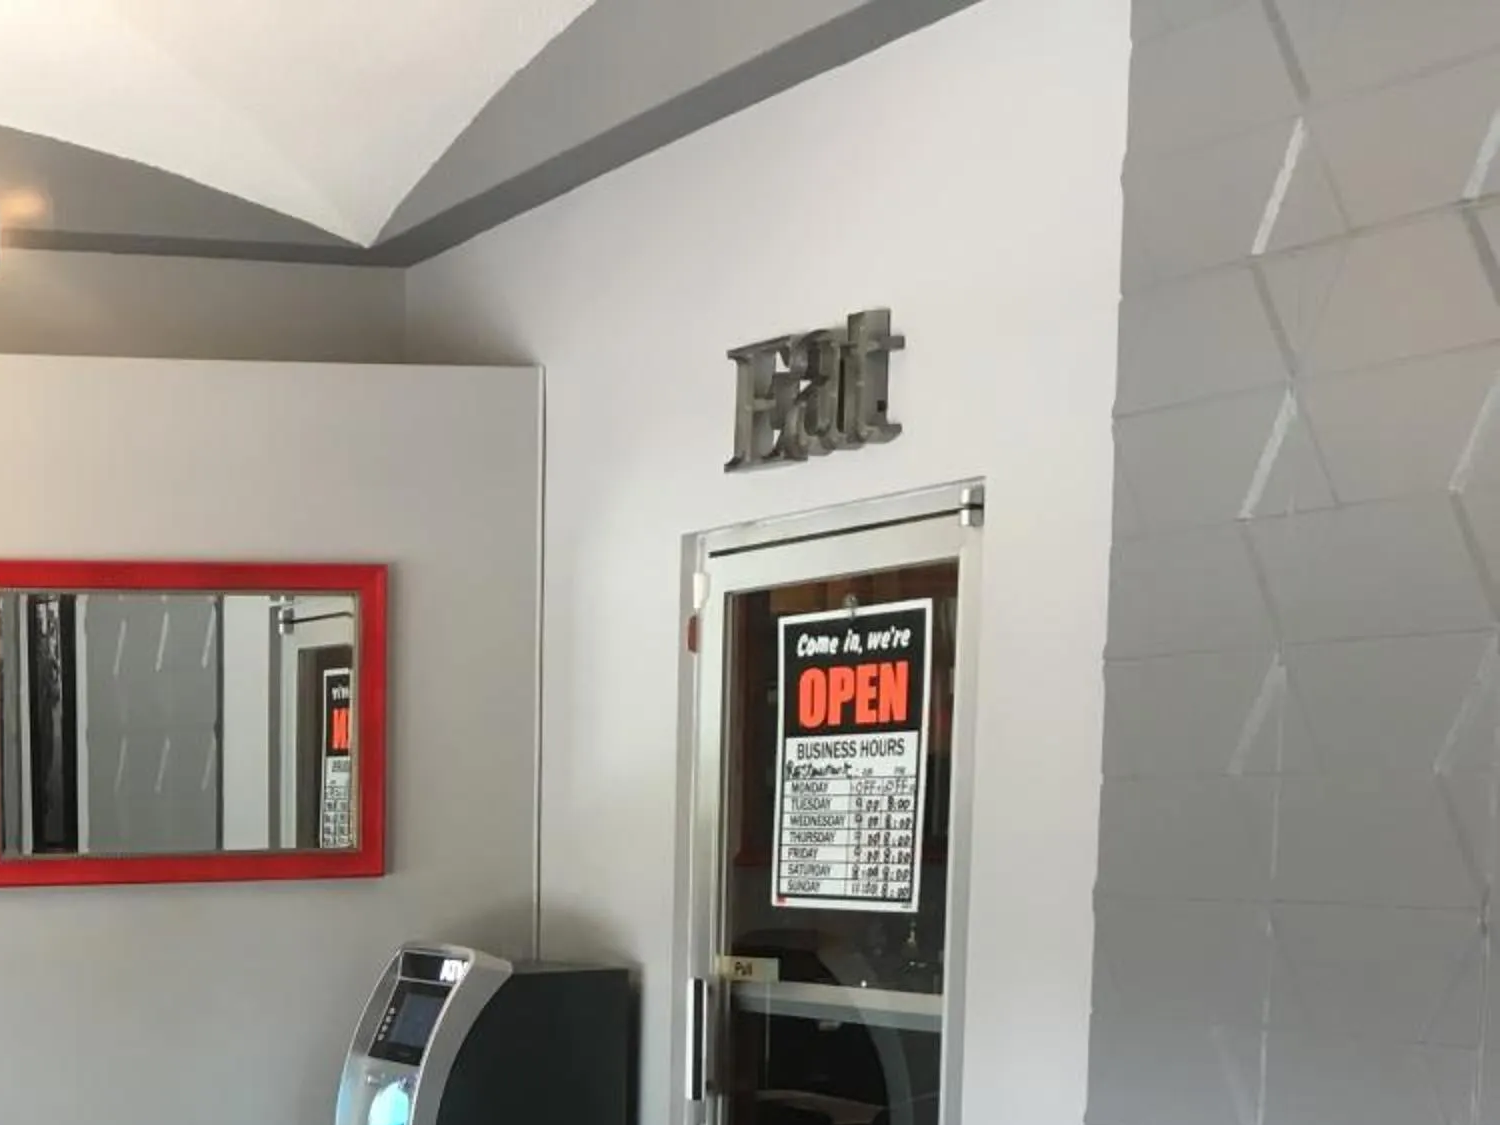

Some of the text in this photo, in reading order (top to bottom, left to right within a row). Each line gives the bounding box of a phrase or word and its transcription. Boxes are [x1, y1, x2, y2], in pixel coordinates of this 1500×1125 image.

[797, 626, 911, 657] Come in, we're
[798, 660, 909, 729] OPEN
[797, 738, 905, 760] BUSINESS HOURS
[791, 782, 829, 793] MONDAY
[791, 797, 832, 810] TUESDAY
[790, 813, 845, 827] WEDNESDAY
[789, 831, 836, 843] THURSDAY
[788, 847, 819, 859] FRIDAY
[788, 863, 831, 876] SATURDAY
[788, 879, 821, 892] SUNDAY
